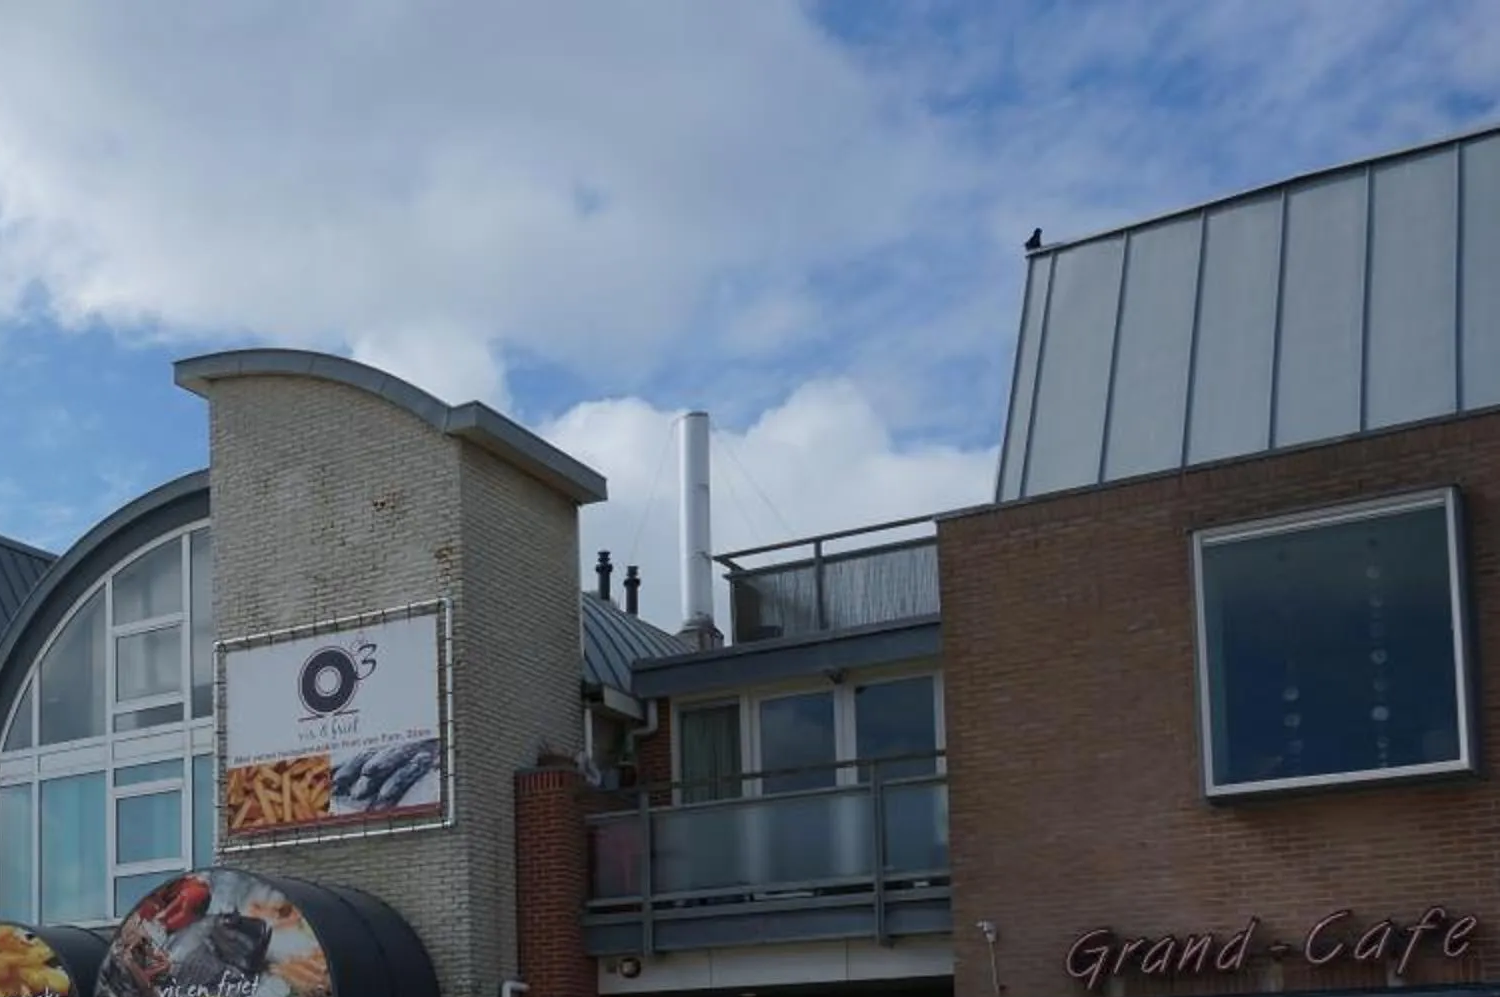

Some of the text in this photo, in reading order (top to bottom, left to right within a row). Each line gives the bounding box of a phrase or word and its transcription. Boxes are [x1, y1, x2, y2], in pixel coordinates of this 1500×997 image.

[1065, 914, 1261, 990] Grand
[1304, 904, 1479, 977] Cafe
[187, 983, 209, 997] en
